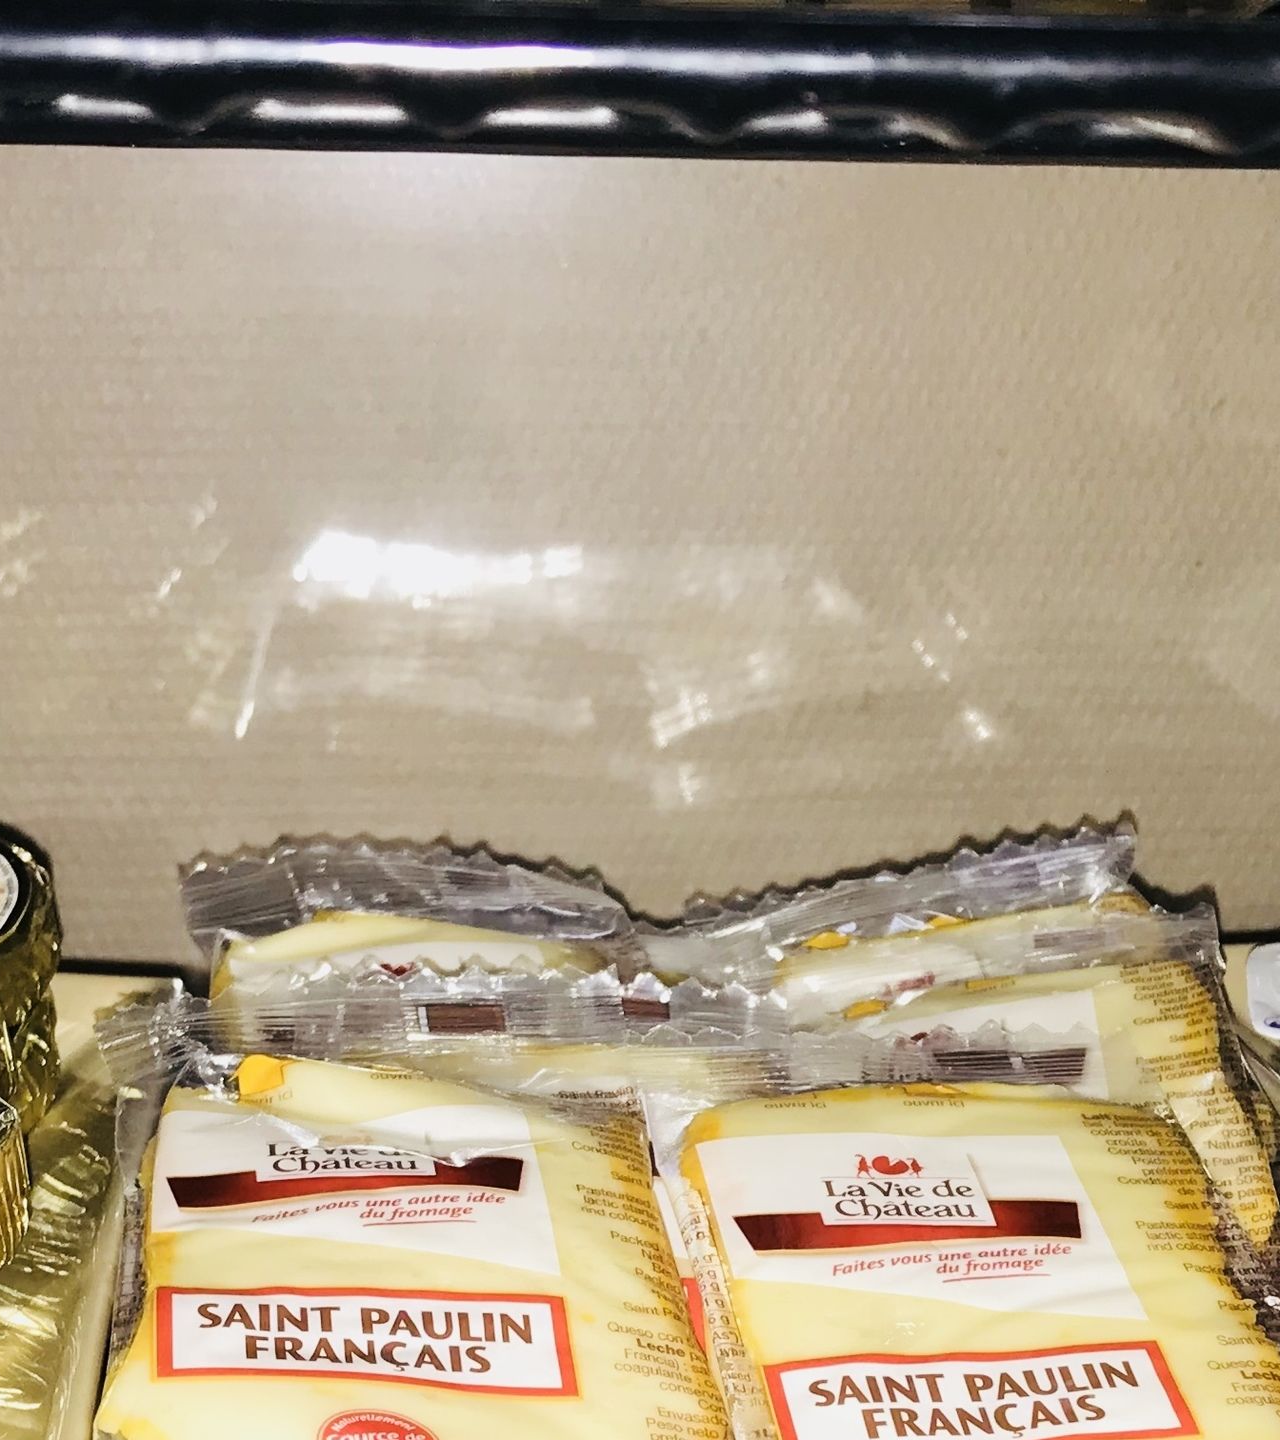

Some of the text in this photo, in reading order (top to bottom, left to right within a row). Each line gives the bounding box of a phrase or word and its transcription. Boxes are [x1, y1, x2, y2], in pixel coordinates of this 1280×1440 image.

[822, 1179, 975, 1198] La Vie de
[252, 1191, 506, 1223] Faites vous une autre idée
[359, 1203, 474, 1222] du fromage
[835, 1198, 978, 1220] Château
[832, 1243, 1073, 1276] Faites vous une autre idée
[936, 1257, 1044, 1276] du fromage
[197, 1303, 534, 1345] SAINT PAULIN
[607, 1321, 684, 1344] Queso con
[244, 1335, 492, 1374] FRANÇAIS
[635, 1337, 686, 1358] Leche
[614, 1362, 693, 1384] coagulante
[1206, 1359, 1256, 1371] Queso
[808, 1360, 1140, 1407] SAINT PAULIN
[645, 1416, 684, 1433] Peso
[657, 1405, 729, 1428] Envasado
[861, 1394, 1107, 1440] FRANÇAIS
